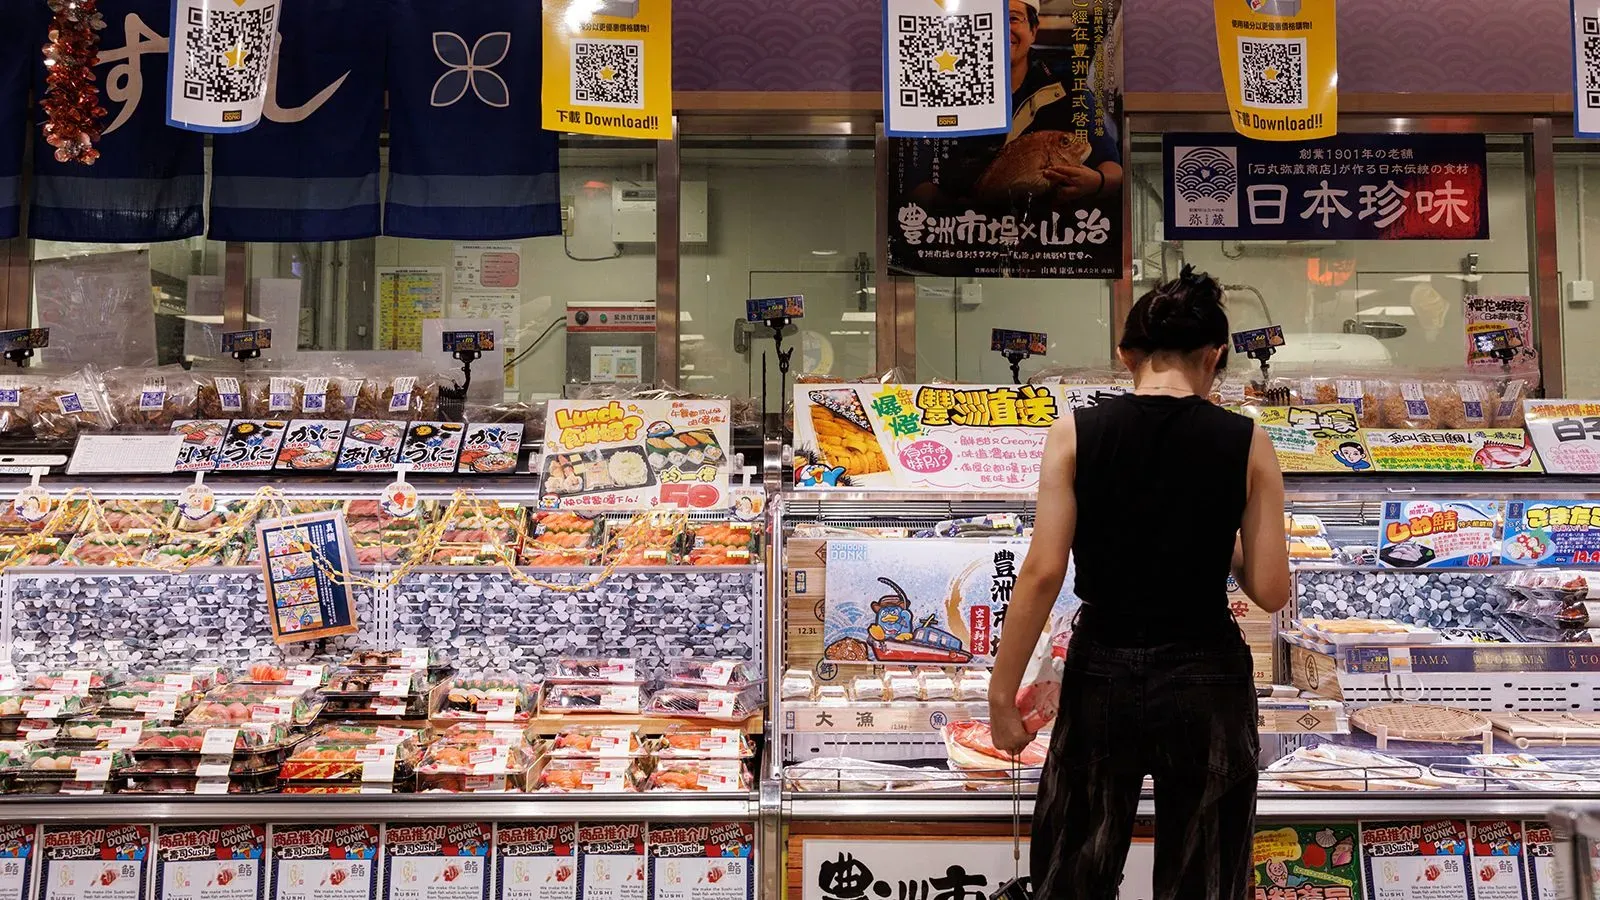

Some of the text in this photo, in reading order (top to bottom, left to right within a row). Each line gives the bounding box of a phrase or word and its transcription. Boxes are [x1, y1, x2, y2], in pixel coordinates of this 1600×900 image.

[585, 112, 658, 130] Download!!
[1253, 113, 1323, 131] Download!!
[1246, 180, 1471, 229] 日本珍味
[555, 401, 624, 428] Lunch
[1387, 510, 1458, 543] しめ鯖
[832, 551, 867, 560] DONKI
[1231, 601, 1249, 617] 安
[107, 831, 141, 847] DONKI
[222, 831, 256, 847] DONKI
[336, 830, 369, 846] DONKI
[449, 828, 482, 844] DONKI
[711, 828, 744, 845] DONKI
[1424, 826, 1457, 843] DONKI
[1480, 826, 1513, 843] DONKI
